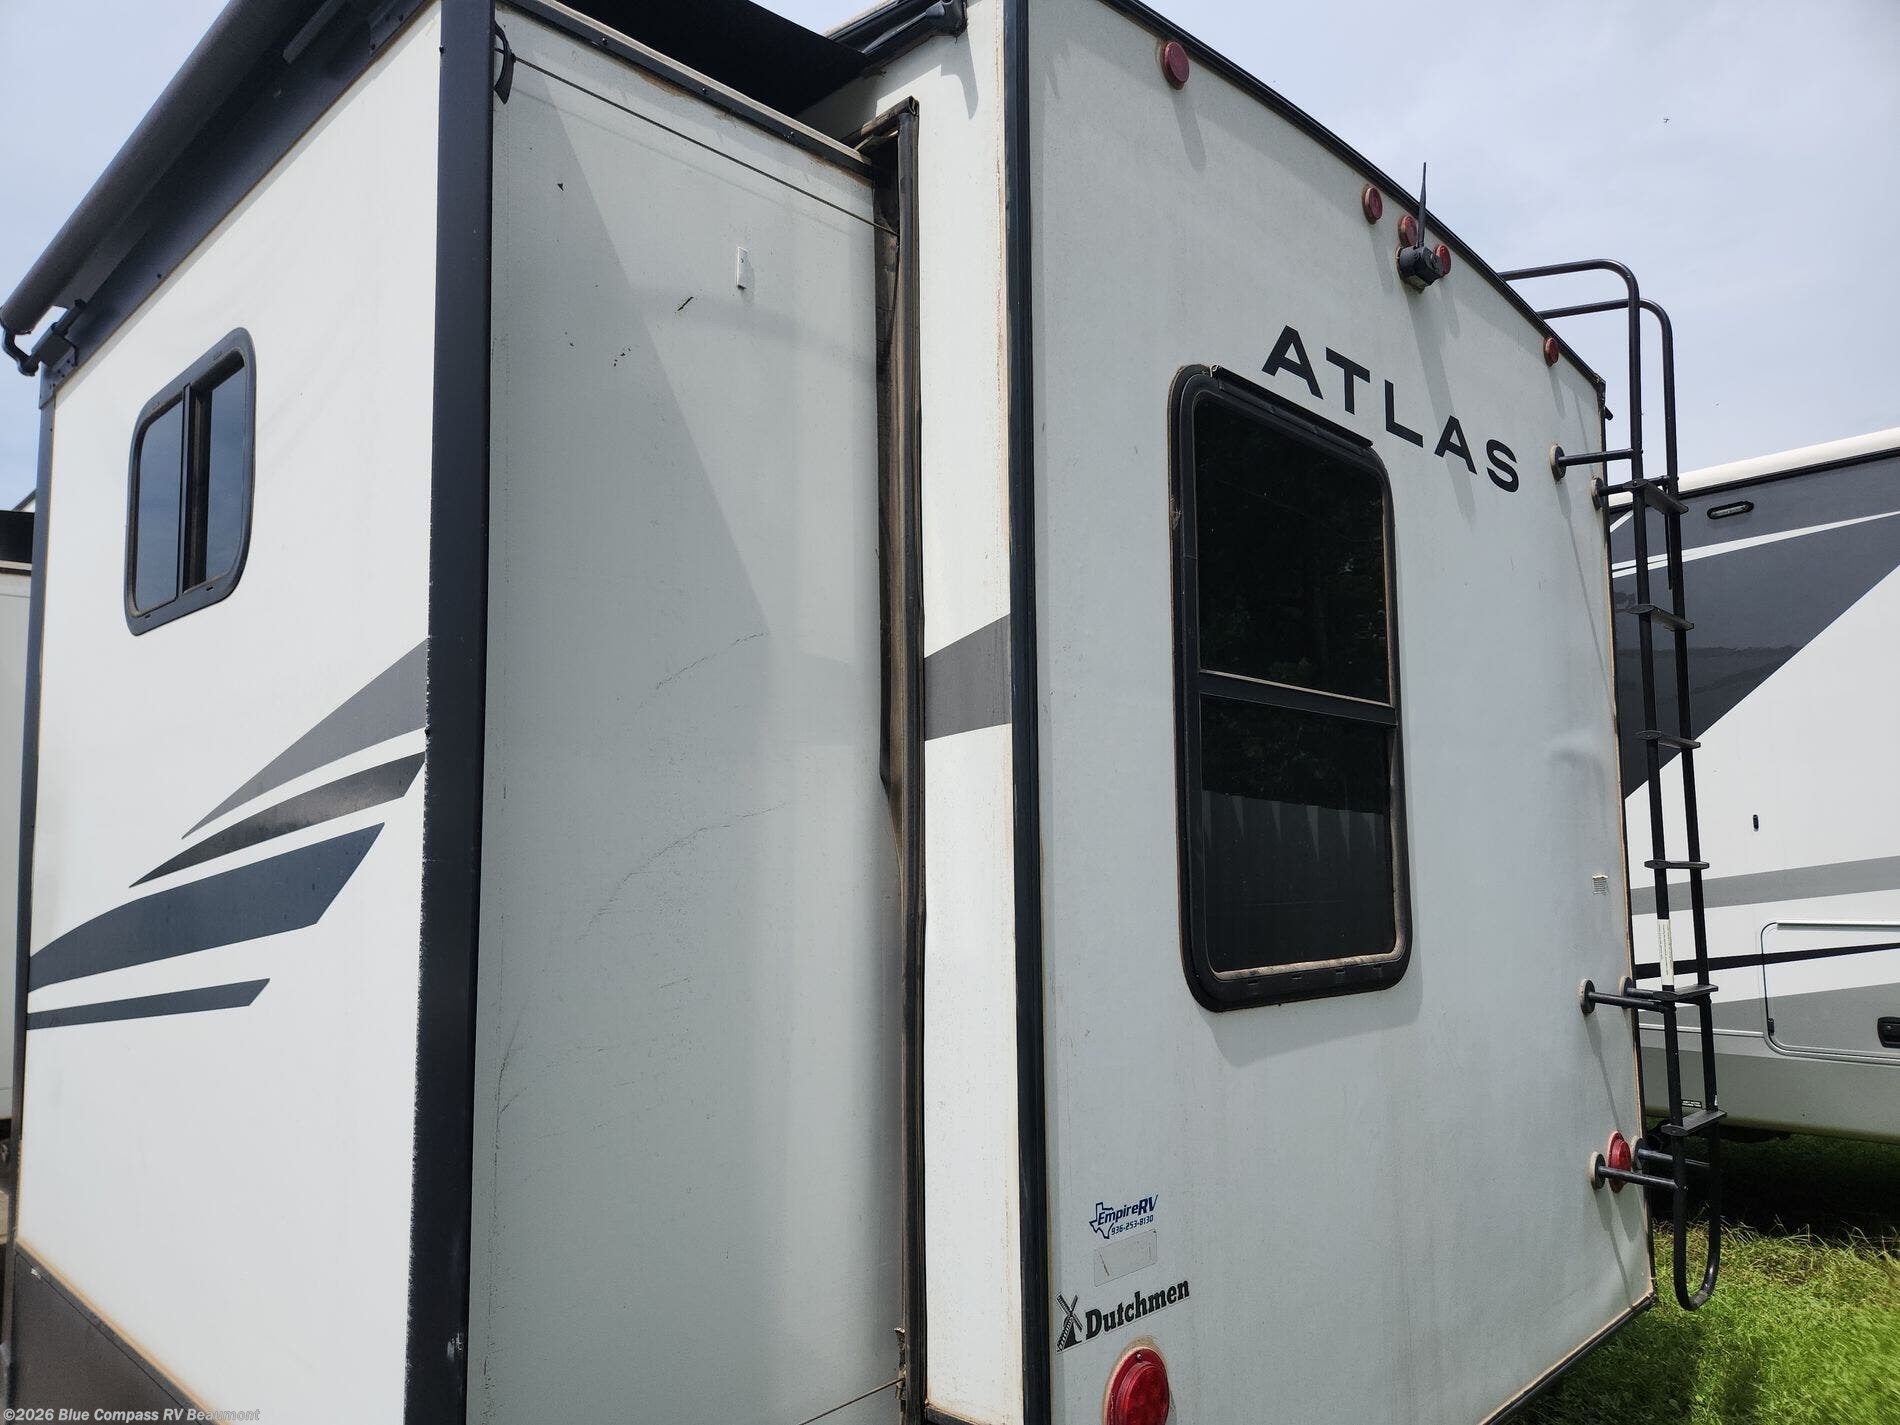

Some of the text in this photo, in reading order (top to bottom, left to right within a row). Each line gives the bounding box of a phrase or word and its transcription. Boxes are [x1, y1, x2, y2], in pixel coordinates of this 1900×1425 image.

[1261, 325, 1519, 492] ATLAS
[1097, 1194, 1159, 1226] EmpireRV
[1111, 1215, 1154, 1236] 936-253-8130
[1085, 1280, 1190, 1340] Dutchmen
